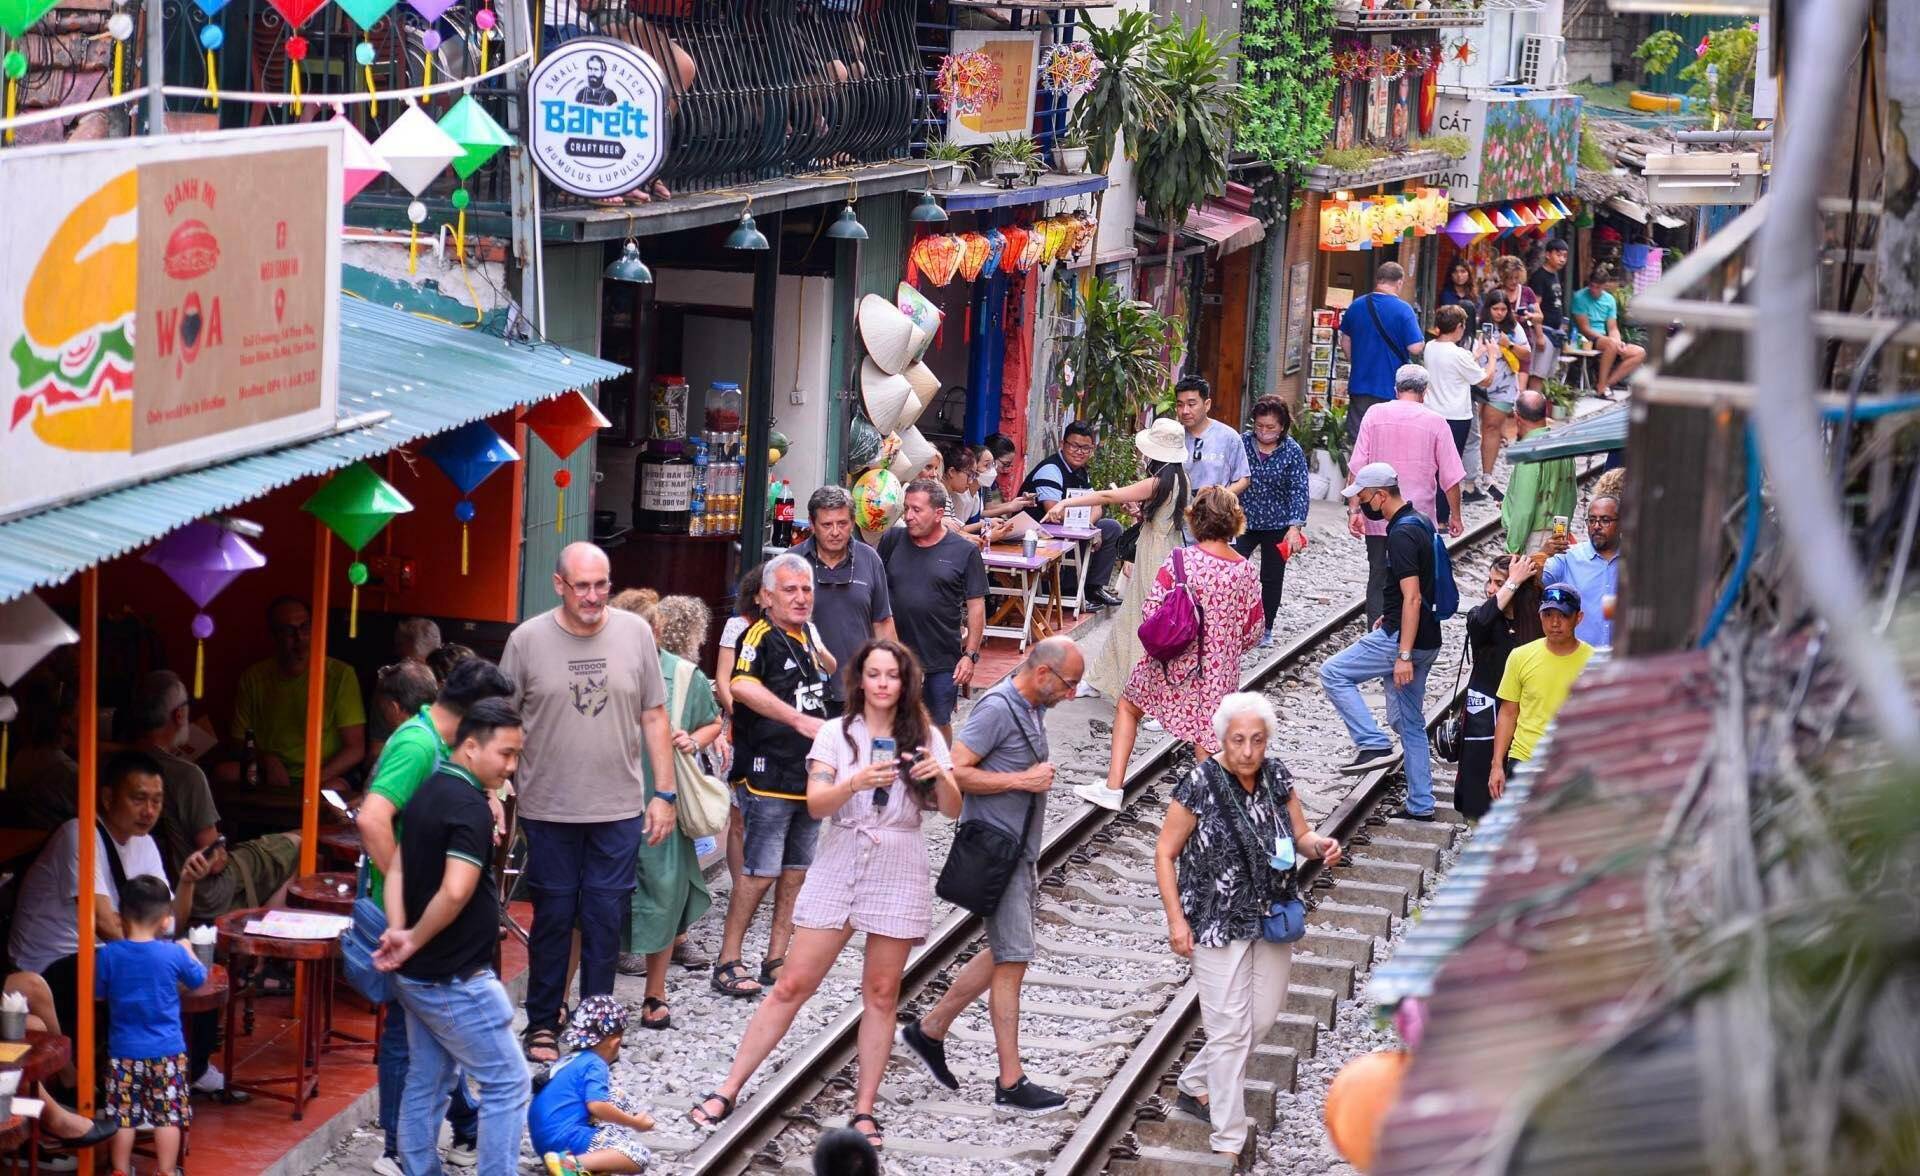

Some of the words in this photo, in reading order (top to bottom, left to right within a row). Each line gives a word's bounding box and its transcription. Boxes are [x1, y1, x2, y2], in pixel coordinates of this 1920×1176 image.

[545, 63, 579, 90] SMALL
[611, 63, 645, 96] BATCH
[540, 101, 649, 139] Barett
[1439, 110, 1472, 132] CẮT
[569, 141, 597, 153] CRAFT
[598, 142, 621, 155] BEER
[545, 146, 592, 183] HUMULUS
[599, 152, 646, 184] LUPULUS
[568, 663, 606, 671] OUTDOOR
